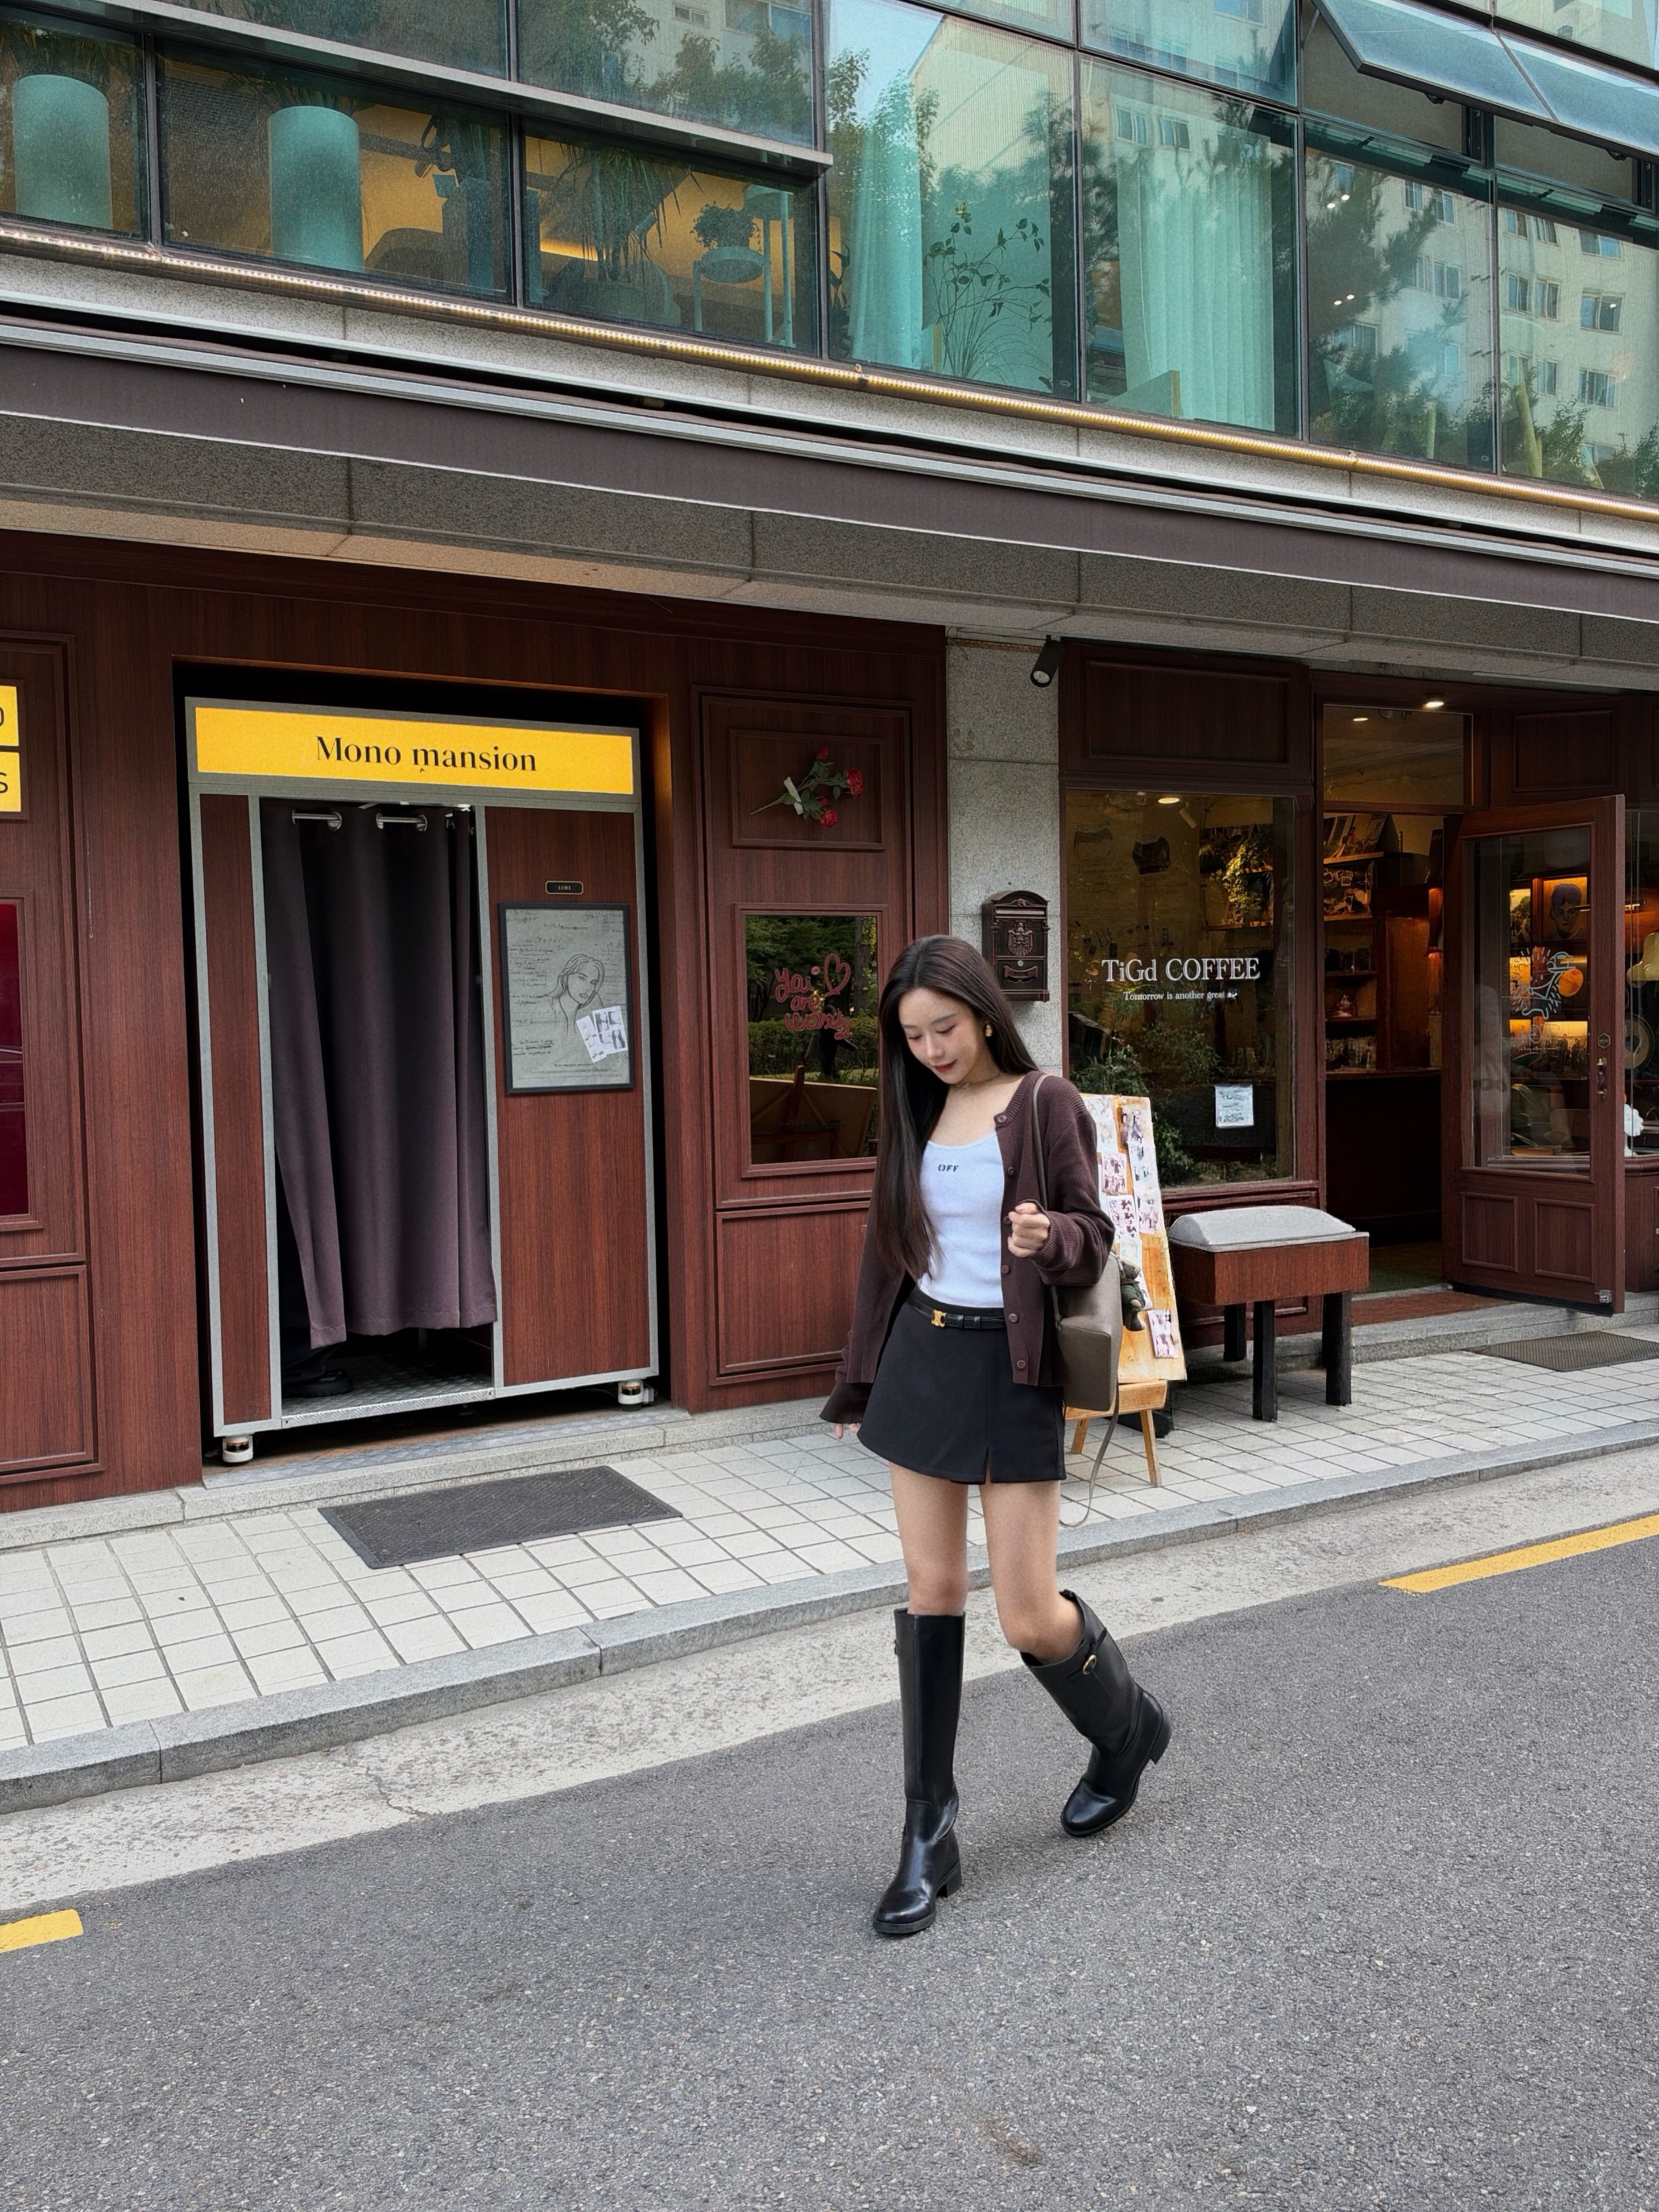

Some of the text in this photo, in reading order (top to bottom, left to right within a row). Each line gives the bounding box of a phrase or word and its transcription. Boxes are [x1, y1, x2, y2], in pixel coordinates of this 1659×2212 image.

[315, 735, 537, 772] Mono mansion
[1101, 957, 1261, 982] TiGd COFFEE
[1123, 991, 1165, 1001] Tomorrow
[1166, 992, 1173, 1000] is
[1175, 990, 1205, 1000] another
[1206, 991, 1225, 1002] great
